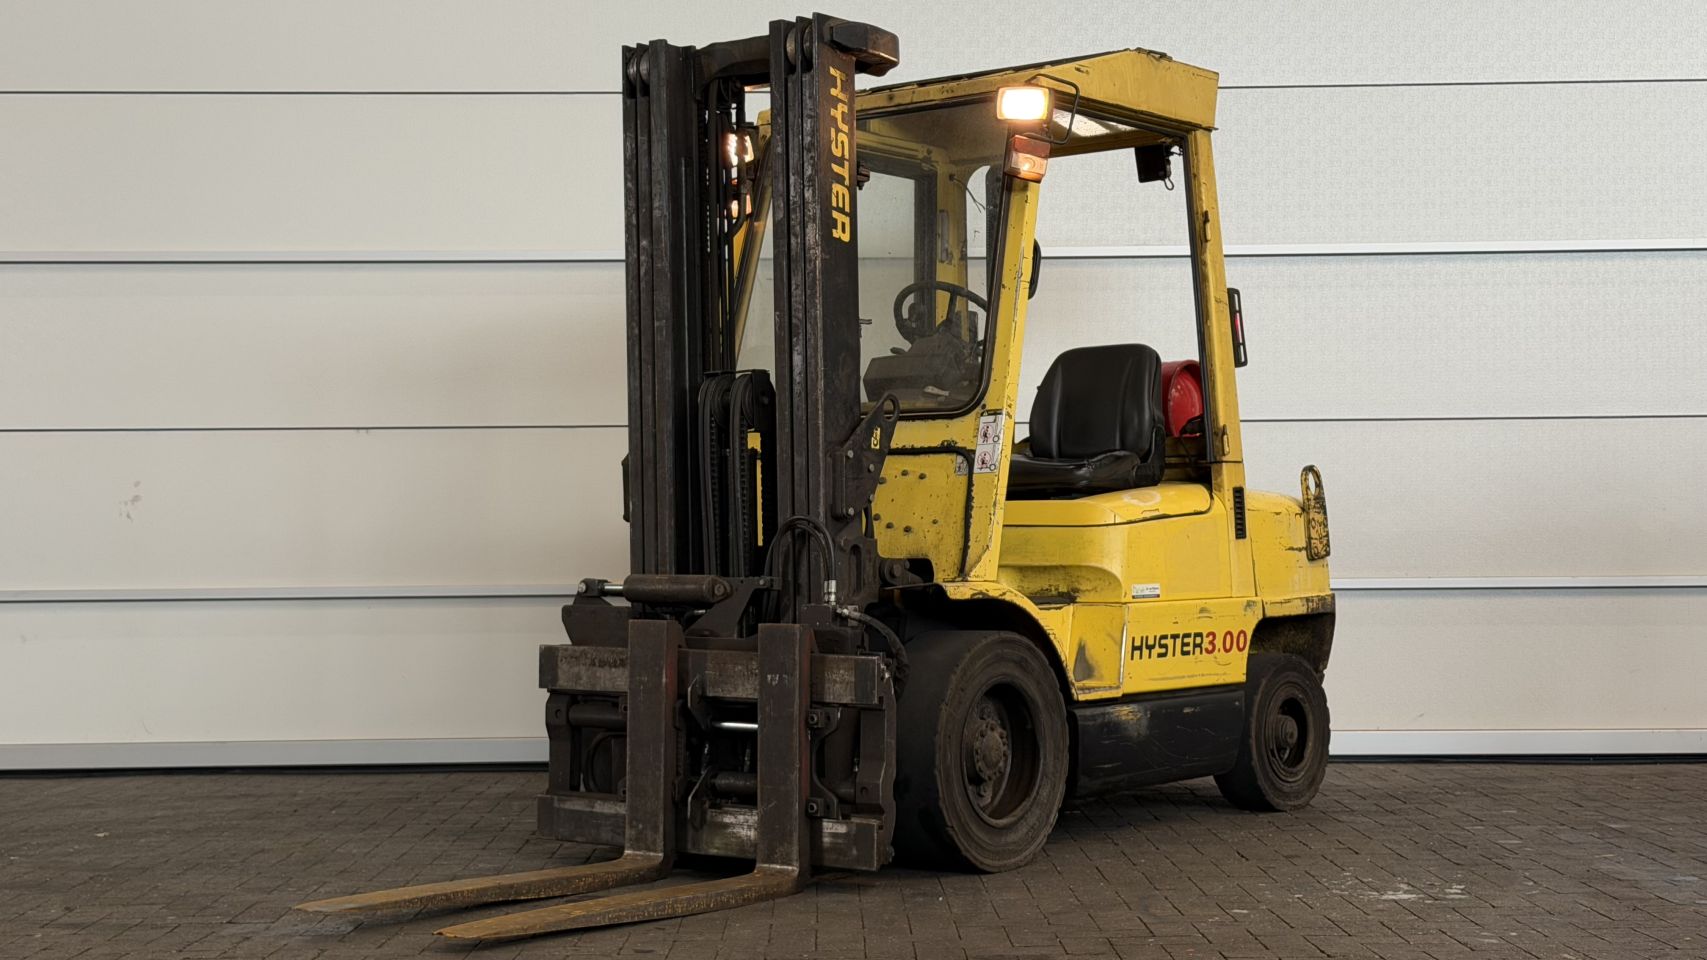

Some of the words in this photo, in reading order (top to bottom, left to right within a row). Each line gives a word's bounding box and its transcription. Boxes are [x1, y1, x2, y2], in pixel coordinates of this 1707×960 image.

[829, 66, 850, 243] HYSTER
[1130, 632, 1204, 661] HYSTER
[1204, 629, 1247, 655] 3.00
